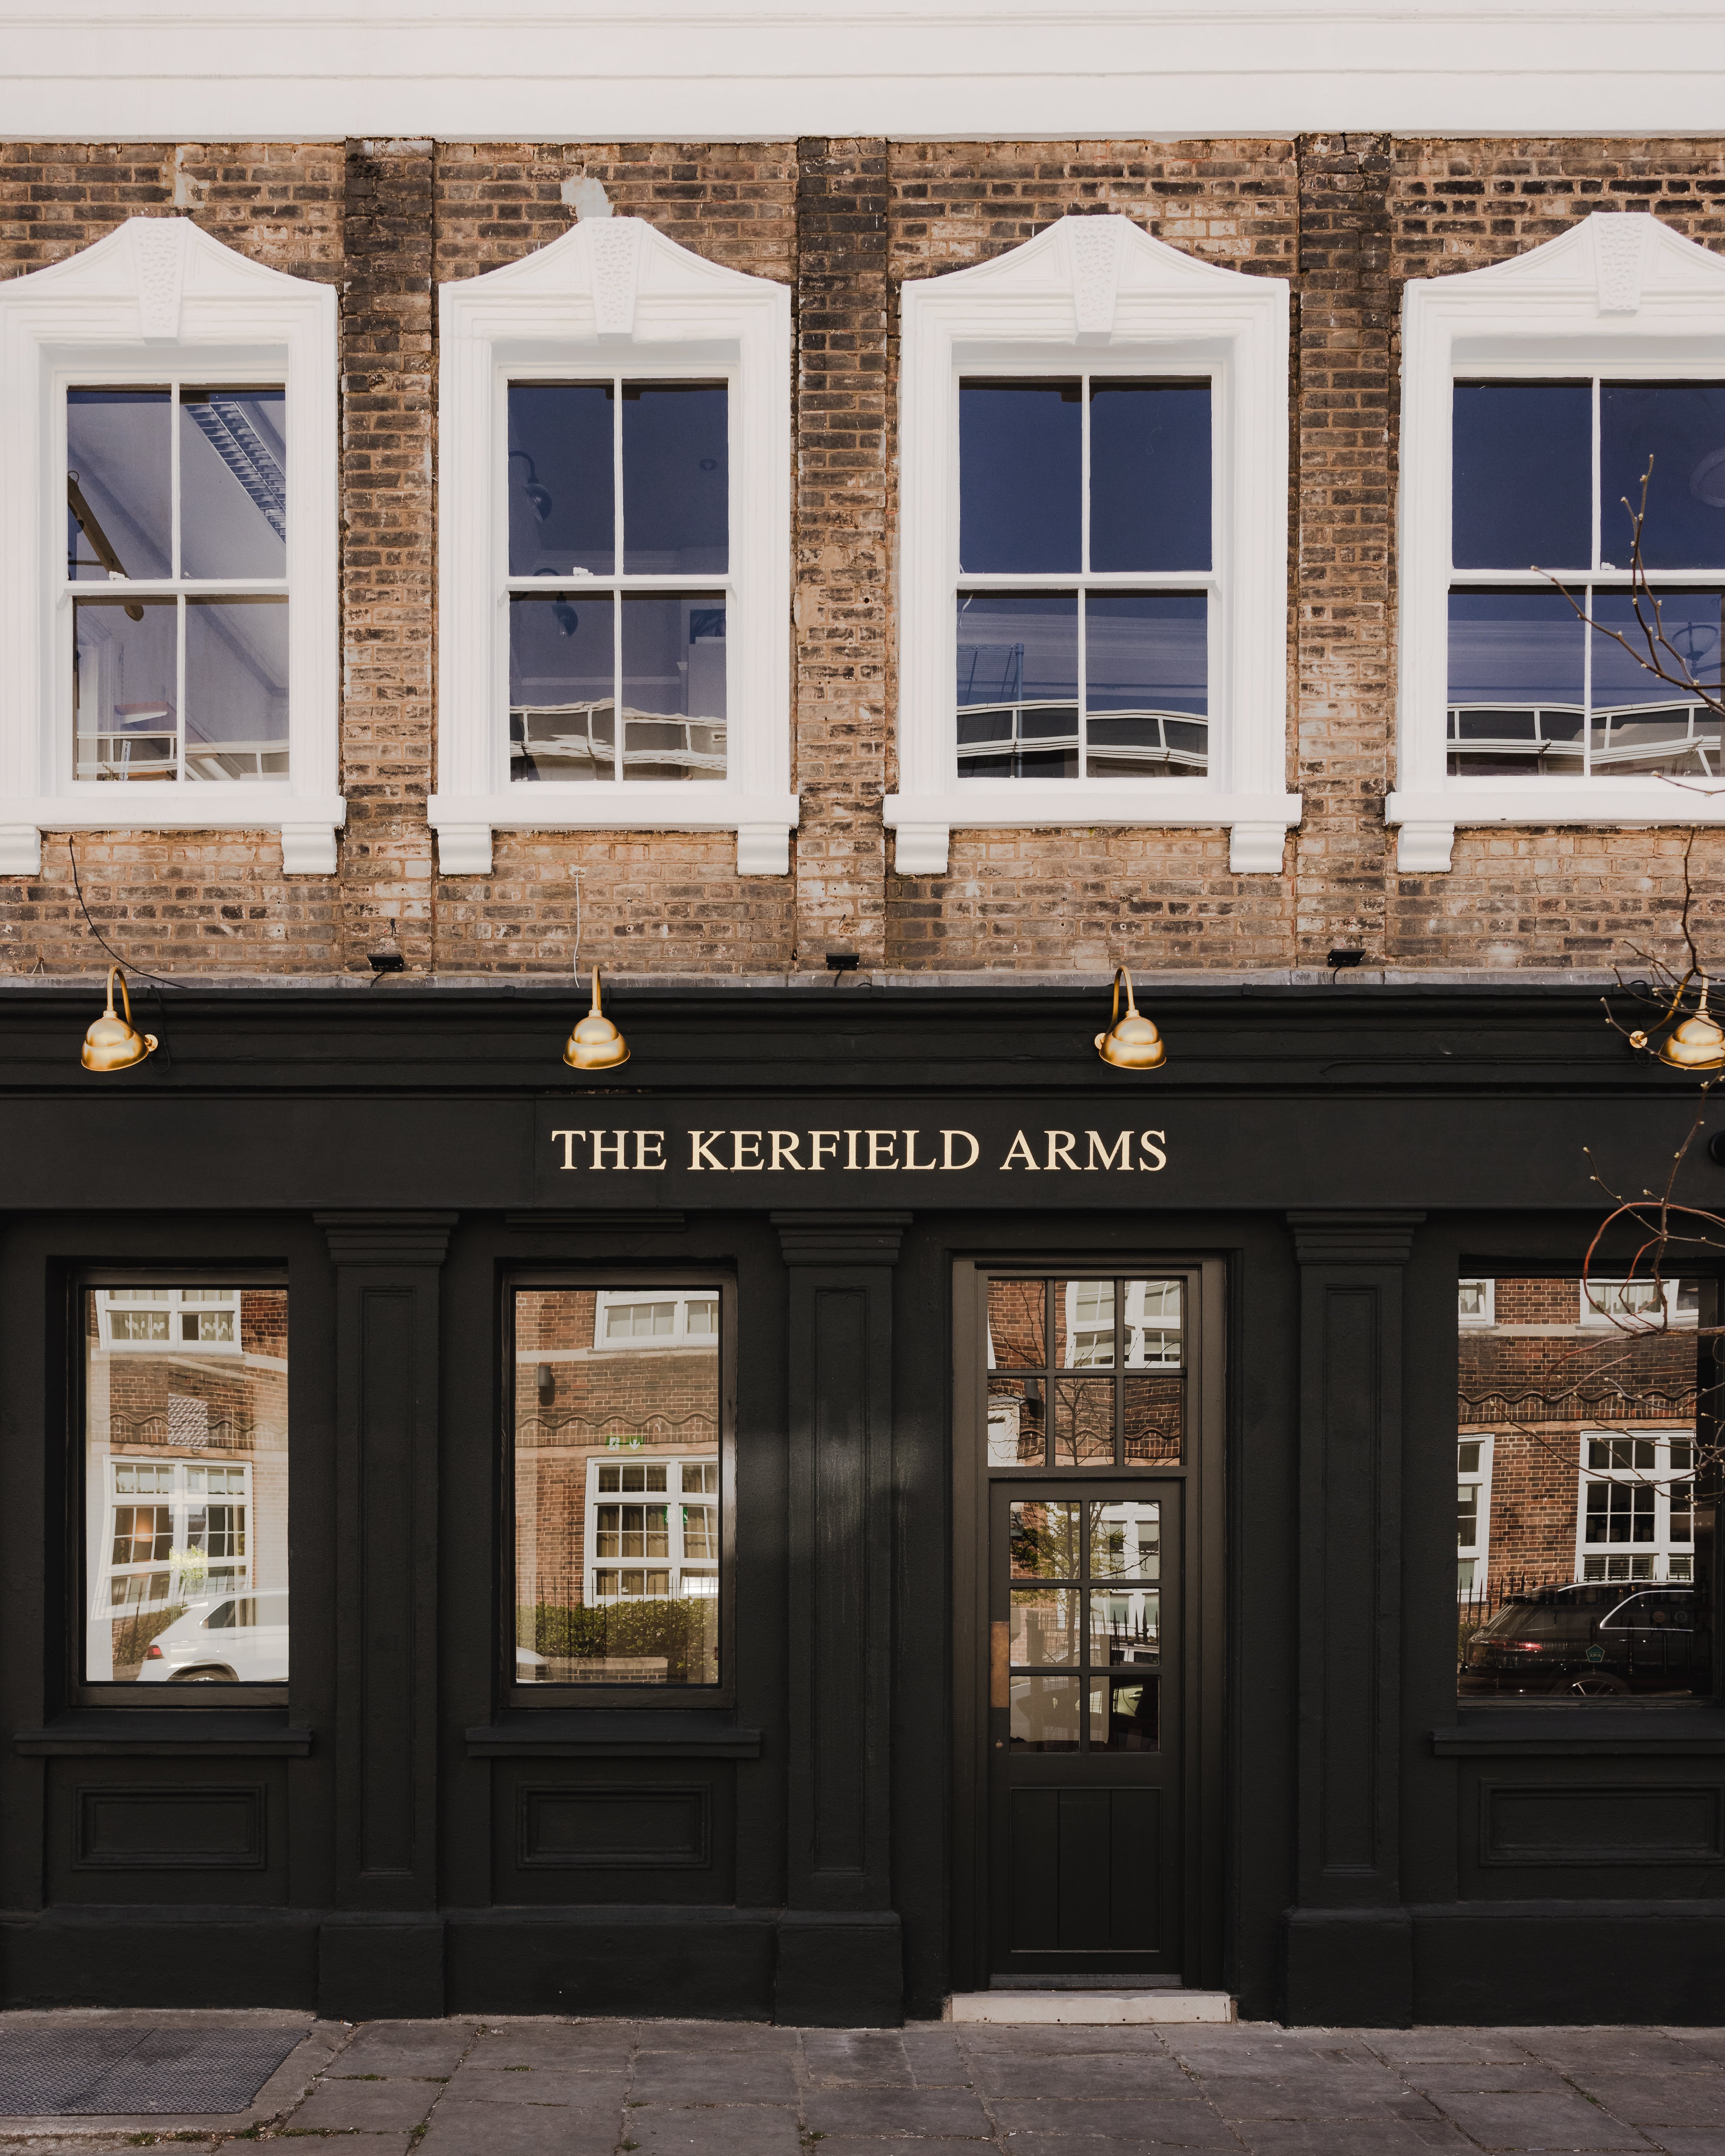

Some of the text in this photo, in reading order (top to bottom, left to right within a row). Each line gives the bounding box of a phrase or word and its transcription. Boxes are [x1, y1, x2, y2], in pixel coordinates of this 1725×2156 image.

[551, 1130, 1167, 1171] THE KERFIELD ARMS
